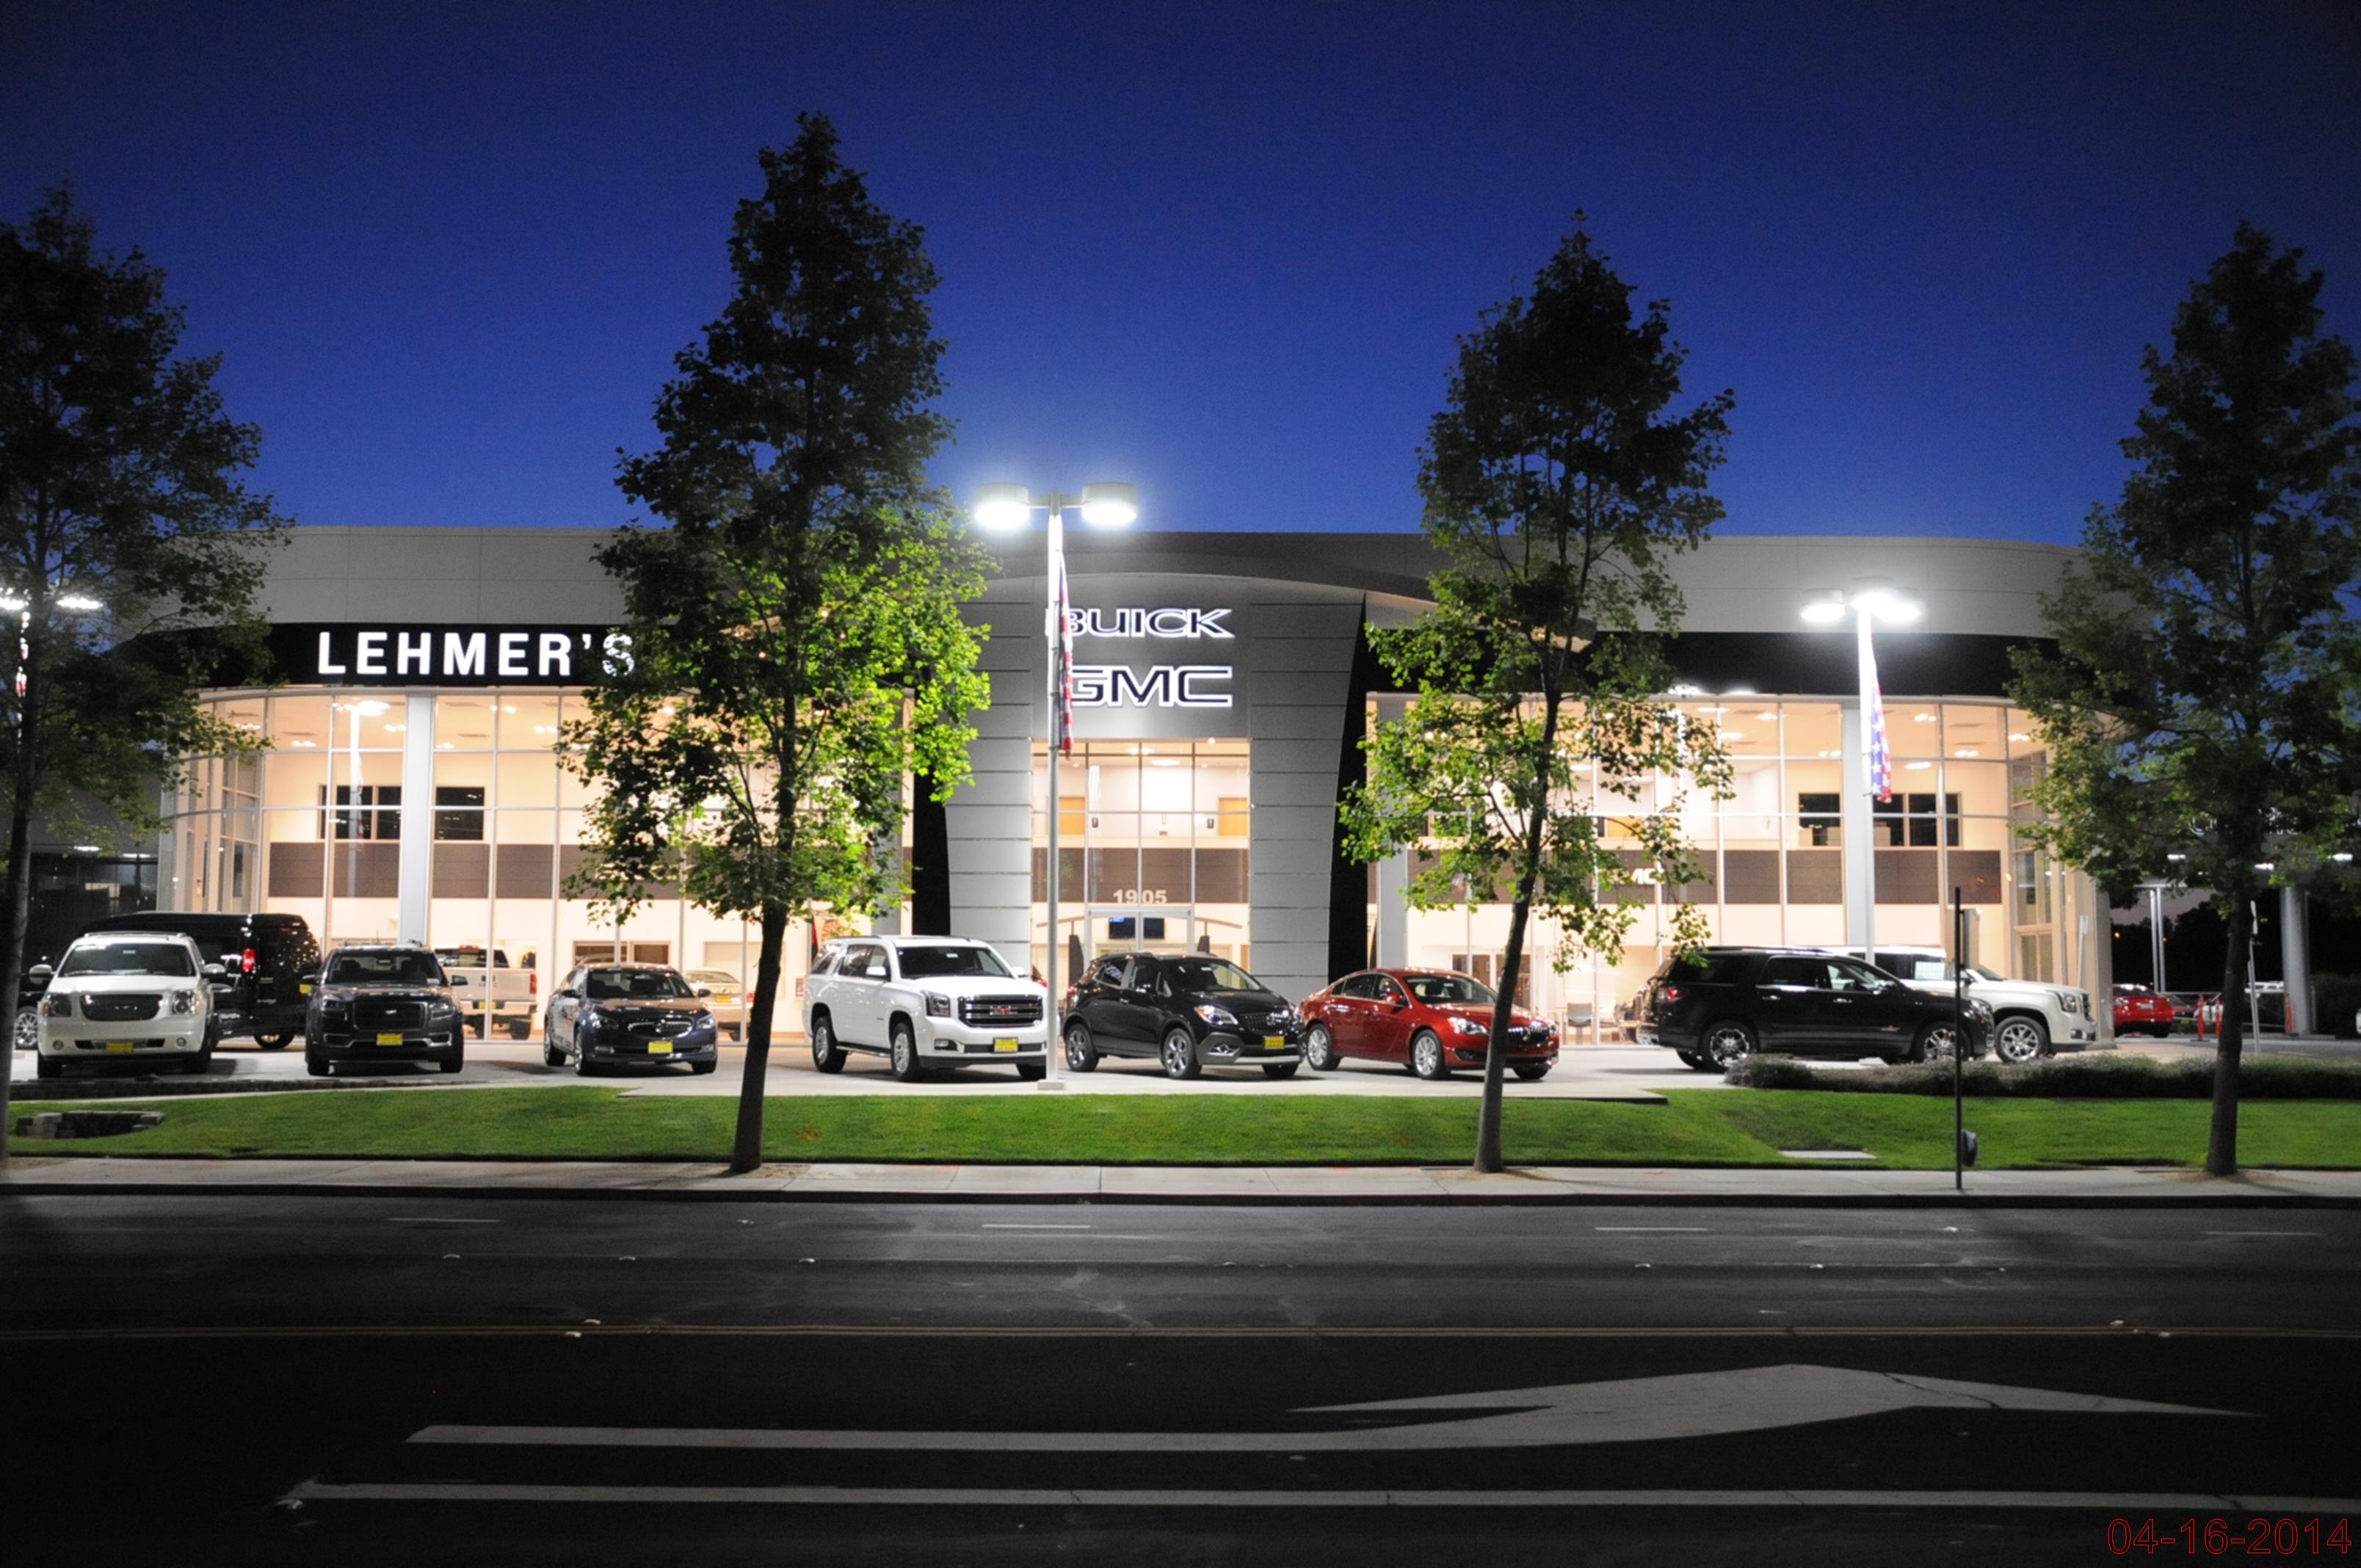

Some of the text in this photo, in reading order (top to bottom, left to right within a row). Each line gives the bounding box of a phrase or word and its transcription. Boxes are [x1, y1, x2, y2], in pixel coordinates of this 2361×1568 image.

[318, 631, 635, 677] LEHMER'S
[1070, 665, 1233, 707] GMC
[1113, 889, 1167, 904] 1905
